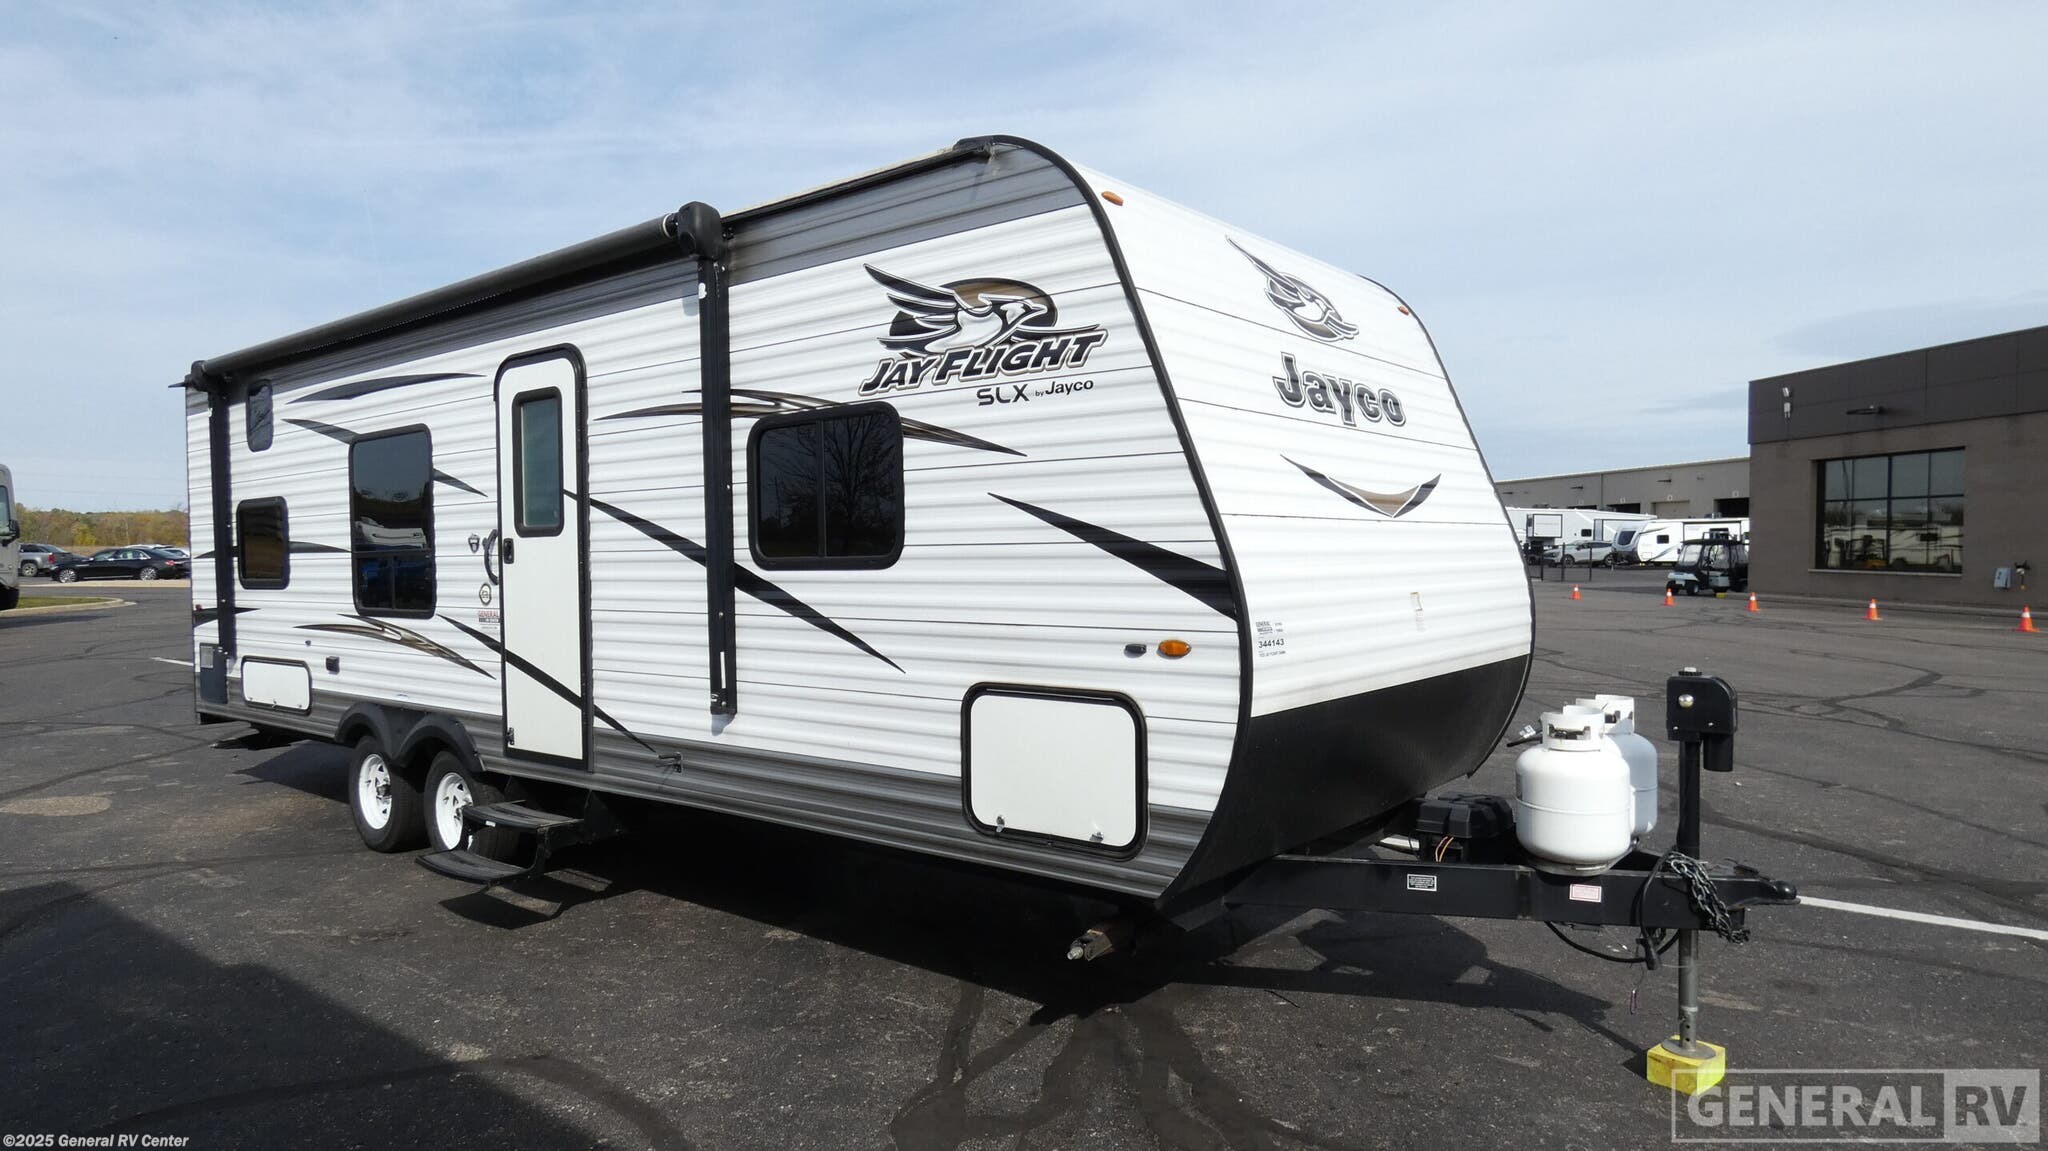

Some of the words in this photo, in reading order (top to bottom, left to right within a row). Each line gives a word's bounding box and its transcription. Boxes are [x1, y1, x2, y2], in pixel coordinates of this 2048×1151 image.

[976, 383, 1031, 407] SLX
[1035, 390, 1045, 398] by
[1045, 379, 1095, 396] Jayco
[1272, 351, 1406, 427] Jayco
[1258, 638, 1285, 649] 344143
